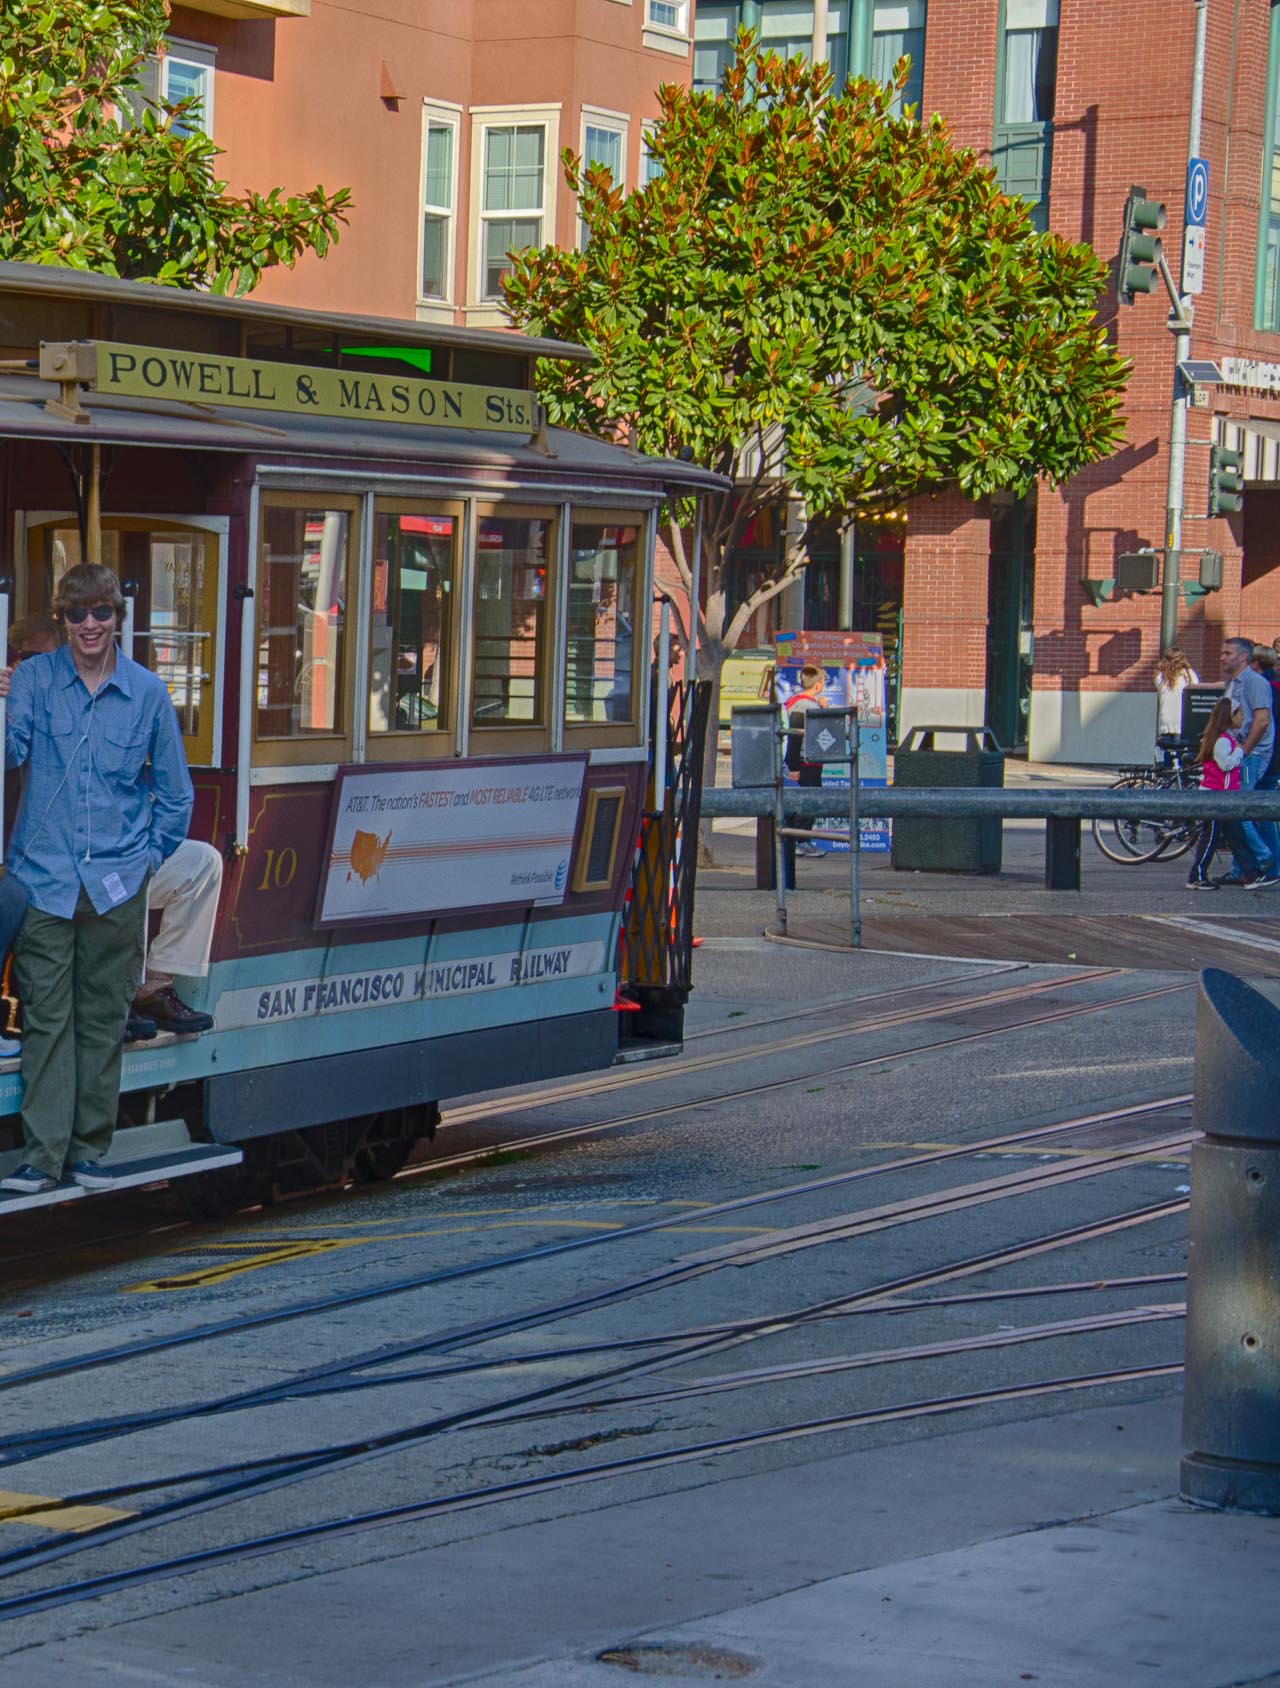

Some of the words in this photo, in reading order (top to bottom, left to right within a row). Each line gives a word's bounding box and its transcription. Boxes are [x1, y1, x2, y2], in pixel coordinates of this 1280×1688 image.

[108, 352, 276, 400] POWELL
[295, 374, 319, 405] &
[338, 379, 462, 418] MASON
[485, 394, 530, 425] Sts.
[345, 795, 370, 813] AT&T.
[370, 795, 385, 811] The
[384, 793, 419, 811] nation's
[419, 790, 455, 809] FASTEST
[452, 791, 470, 807] and
[470, 788, 494, 806] MOST
[493, 785, 529, 805] RELIABLE
[258, 847, 297, 891] 10
[257, 987, 297, 1019] SAN
[302, 971, 405, 1012] FRANCISCO
